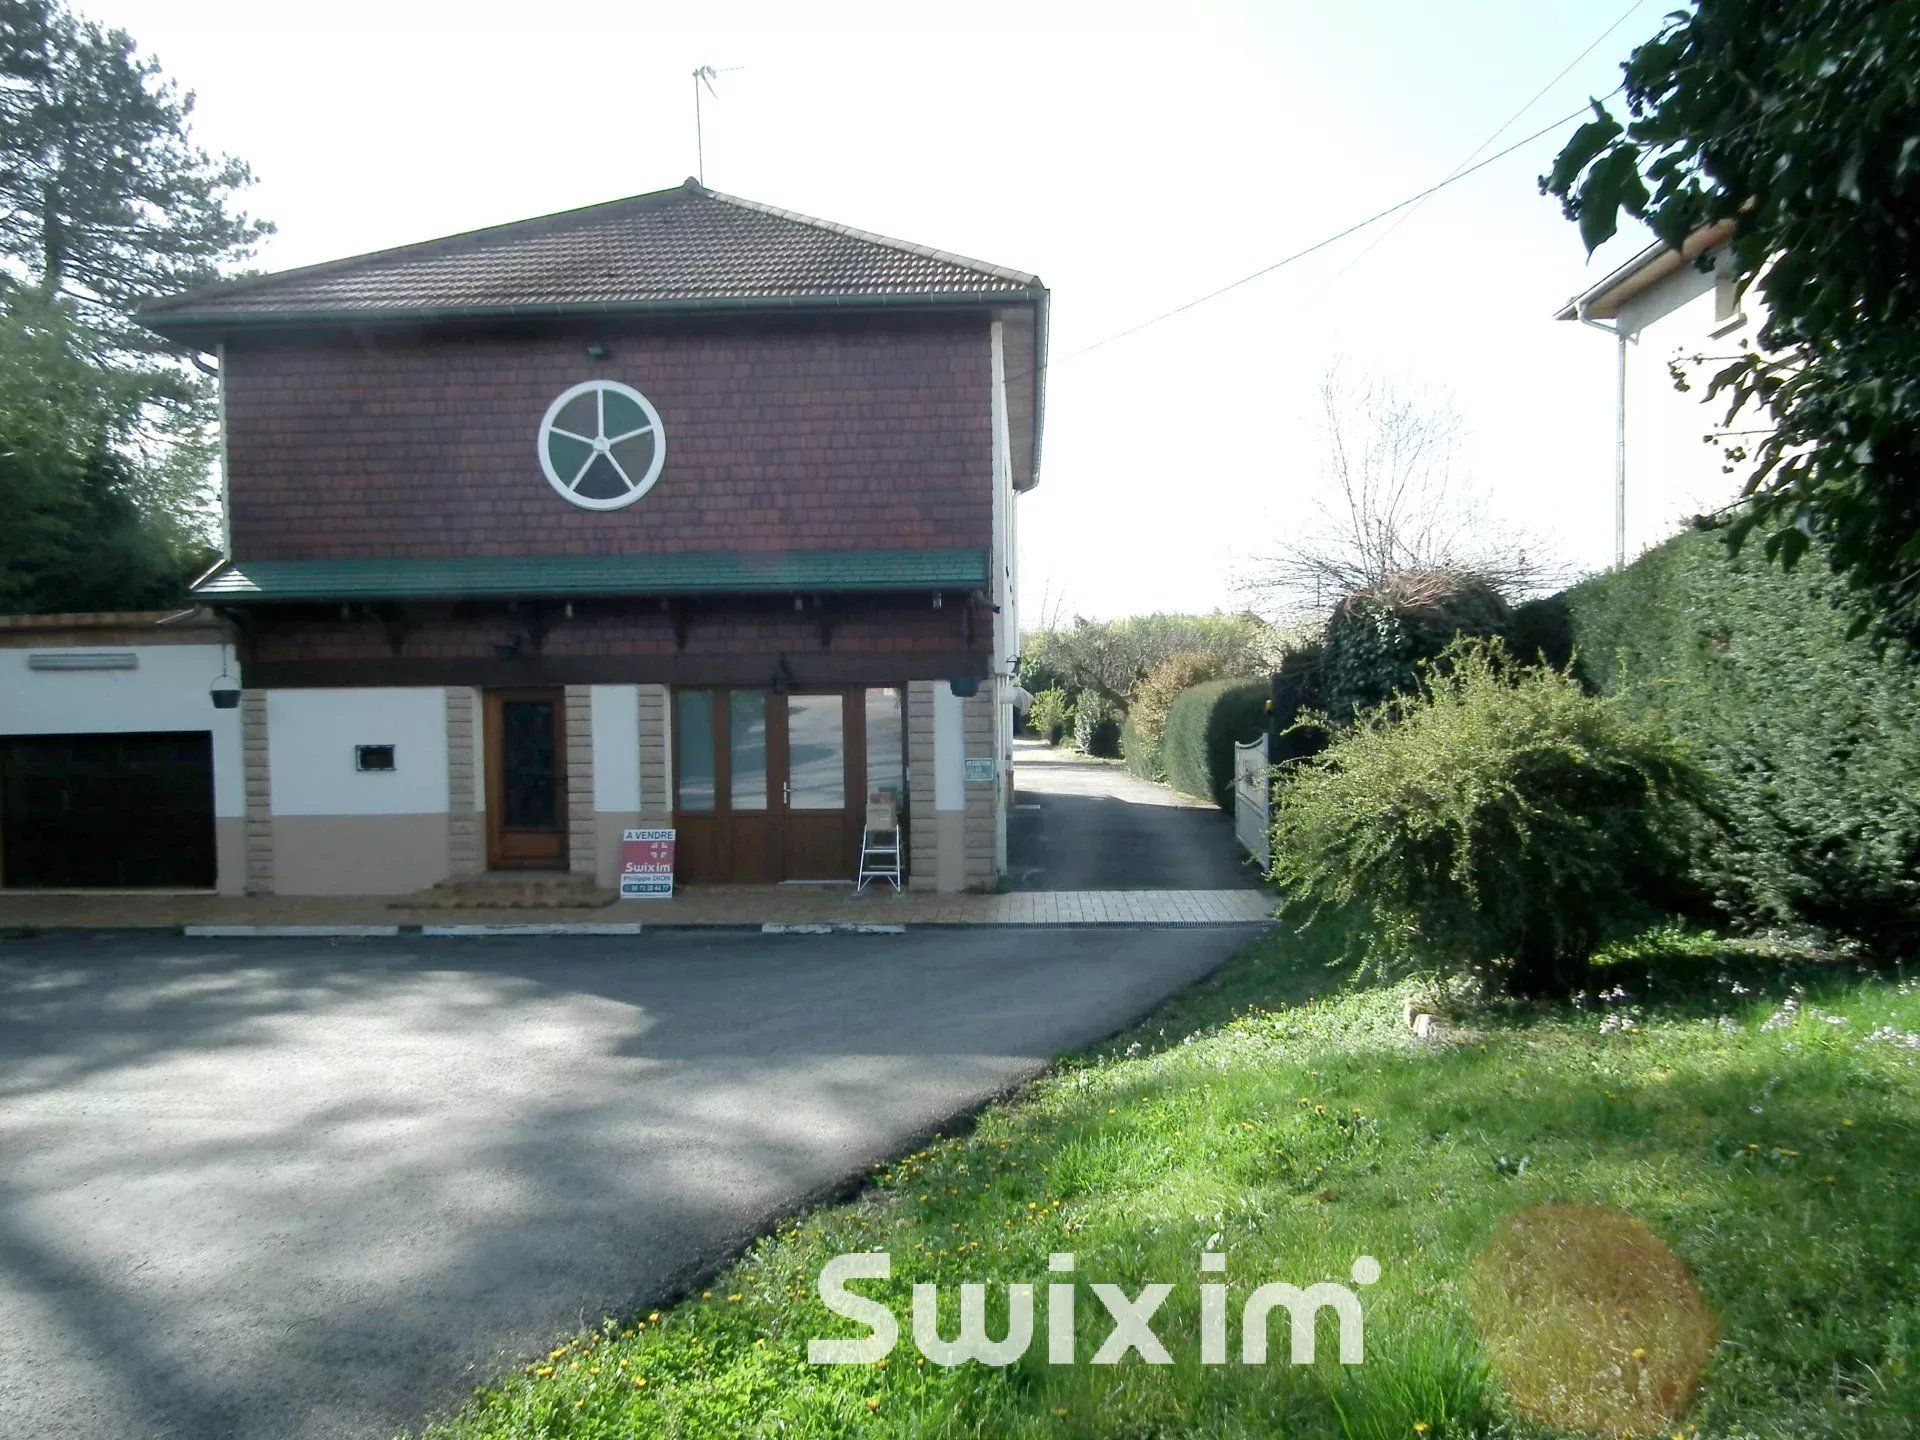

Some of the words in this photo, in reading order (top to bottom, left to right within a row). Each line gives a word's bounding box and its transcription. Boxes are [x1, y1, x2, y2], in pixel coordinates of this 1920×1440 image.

[626, 831, 633, 839] A
[635, 831, 674, 839] VENDRE
[624, 862, 671, 872] Swixim
